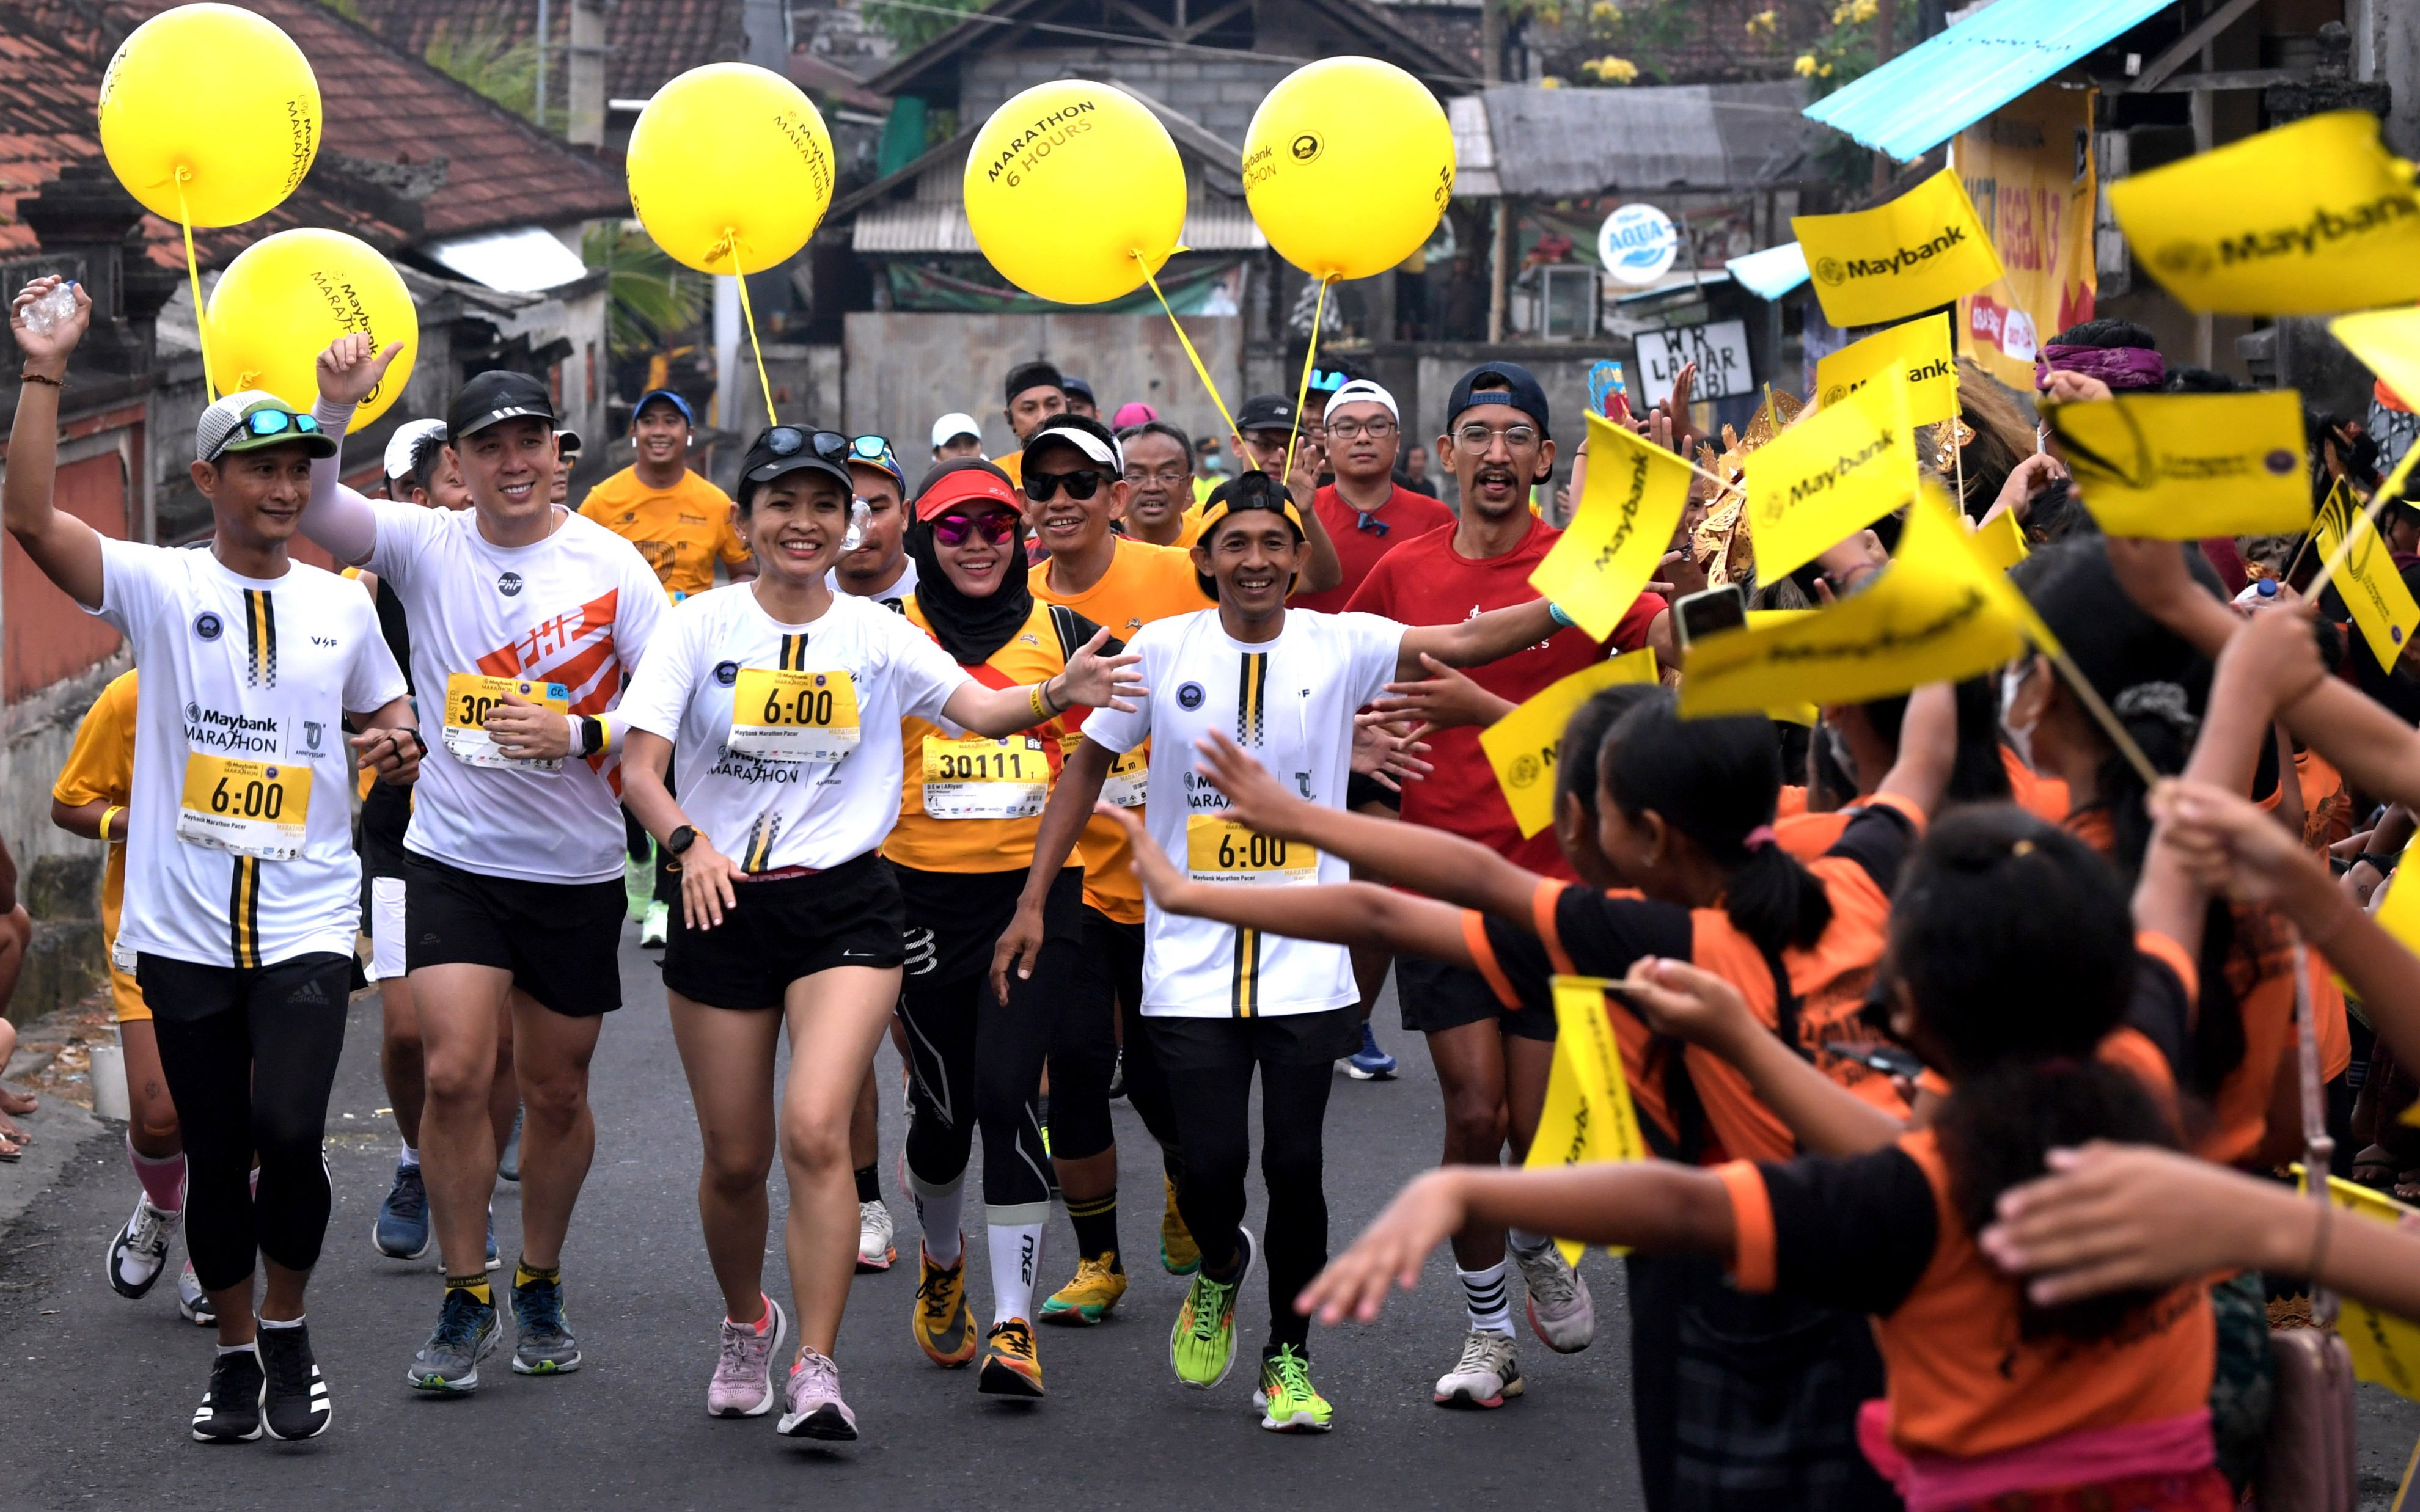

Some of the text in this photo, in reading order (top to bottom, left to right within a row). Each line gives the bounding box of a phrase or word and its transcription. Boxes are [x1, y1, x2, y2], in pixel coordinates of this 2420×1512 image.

[773, 115, 823, 202] MARATHON
[799, 123, 831, 190] Maybank
[988, 101, 1095, 183] MARATHON
[1007, 119, 1092, 187] 6 HOURS
[1609, 220, 1663, 254] AQUA
[1847, 225, 1966, 279] Maybank
[1690, 373, 1728, 398] ABI
[1789, 429, 1894, 506] Maybank
[1594, 451, 1649, 572] Maybank
[449, 690, 459, 725] MASTER
[551, 688, 563, 697] CC
[764, 688, 832, 725] 6:00
[203, 709, 277, 732] Maybank
[184, 724, 277, 753] MARATHON
[296, 750, 326, 758] ANNIVERSARY
[1027, 739, 1041, 750] BB
[224, 768, 258, 776] MARATHON
[707, 763, 799, 785] MARATHON
[927, 750, 937, 781] MASTER
[940, 753, 1021, 779] 30111
[211, 777, 284, 819] 6:00
[184, 813, 205, 824] Maybank
[206, 818, 230, 828] Marathon
[1219, 833, 1286, 868] 6:00
[287, 994, 329, 1005] adidas
[1021, 1233, 1034, 1287] 2XU
